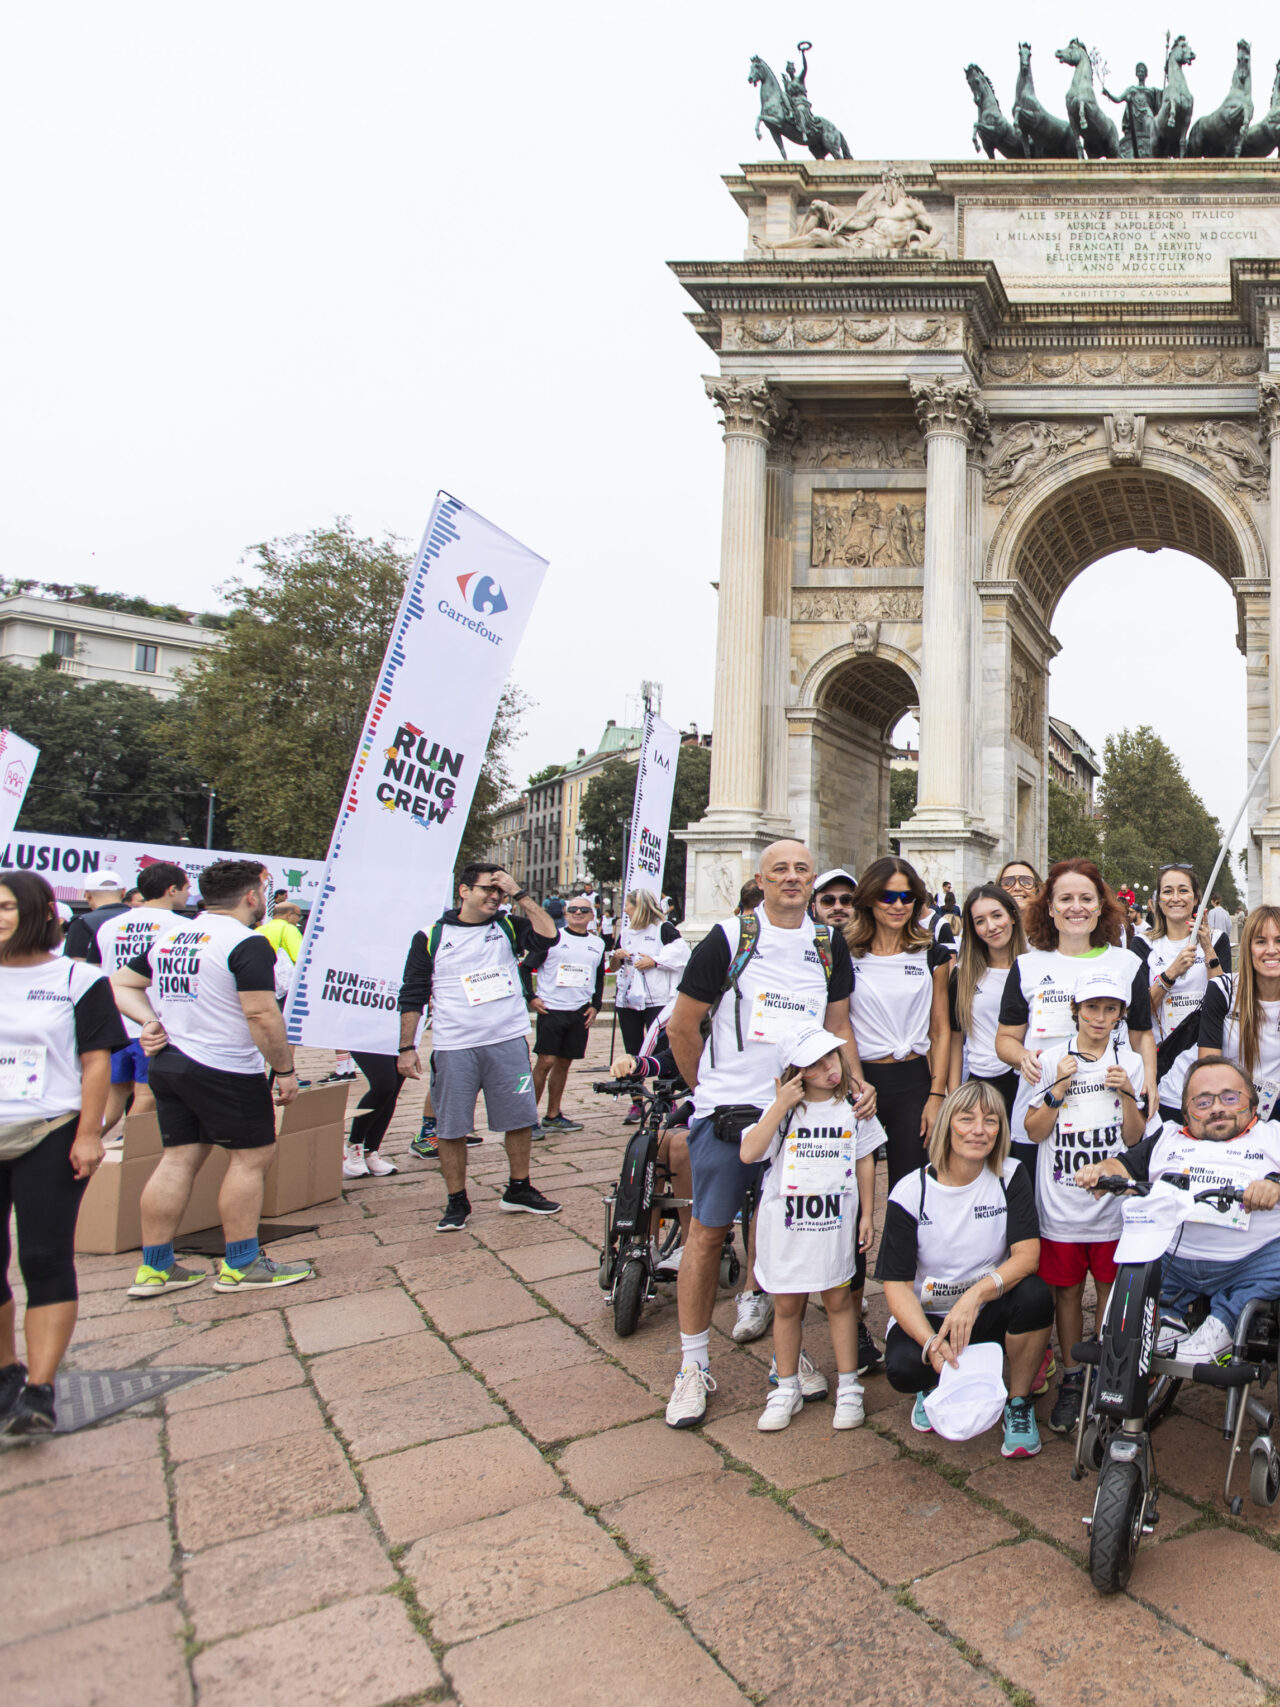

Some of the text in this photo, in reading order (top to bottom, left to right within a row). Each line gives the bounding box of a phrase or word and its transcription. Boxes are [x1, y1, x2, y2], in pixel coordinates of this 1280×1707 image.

[1019, 210, 1234, 220] ALLE SPERANZE DEL REGNO ITALICO
[1067, 222, 1187, 230] AUSPICE NAPOLEONE I
[996, 232, 1000, 241] I
[1008, 232, 1062, 241] MILANESI
[1070, 232, 1141, 241] DEDICARONO
[1162, 232, 1191, 240] ANNO
[1200, 232, 1258, 240] MDCCCVII
[1055, 242, 1060, 251] E
[1069, 242, 1125, 251] FRANCATI
[1134, 242, 1149, 250] DA
[1046, 252, 1212, 262] FELICEMENTE RESTITUIRONO
[1083, 262, 1114, 272] ANNO
[1122, 262, 1186, 272] MDCCCLIX
[438, 600, 503, 646] Carrefour
[392, 726, 464, 778] RUN
[383, 758, 456, 800] NING
[376, 782, 450, 824] CREW
[641, 828, 661, 850] RUN
[639, 844, 660, 863] NING
[638, 857, 660, 874] CREW
[126, 922, 154, 933] RUN
[173, 932, 206, 944] RUN
[170, 946, 188, 956] FOR
[158, 958, 200, 975] INCLU
[159, 976, 190, 993] SION
[325, 968, 359, 987] RUN
[359, 979, 376, 992] FOR
[764, 1000, 805, 1011] INCLUSION
[796, 1150, 839, 1158] INCLUSION
[785, 1195, 840, 1219] SION
